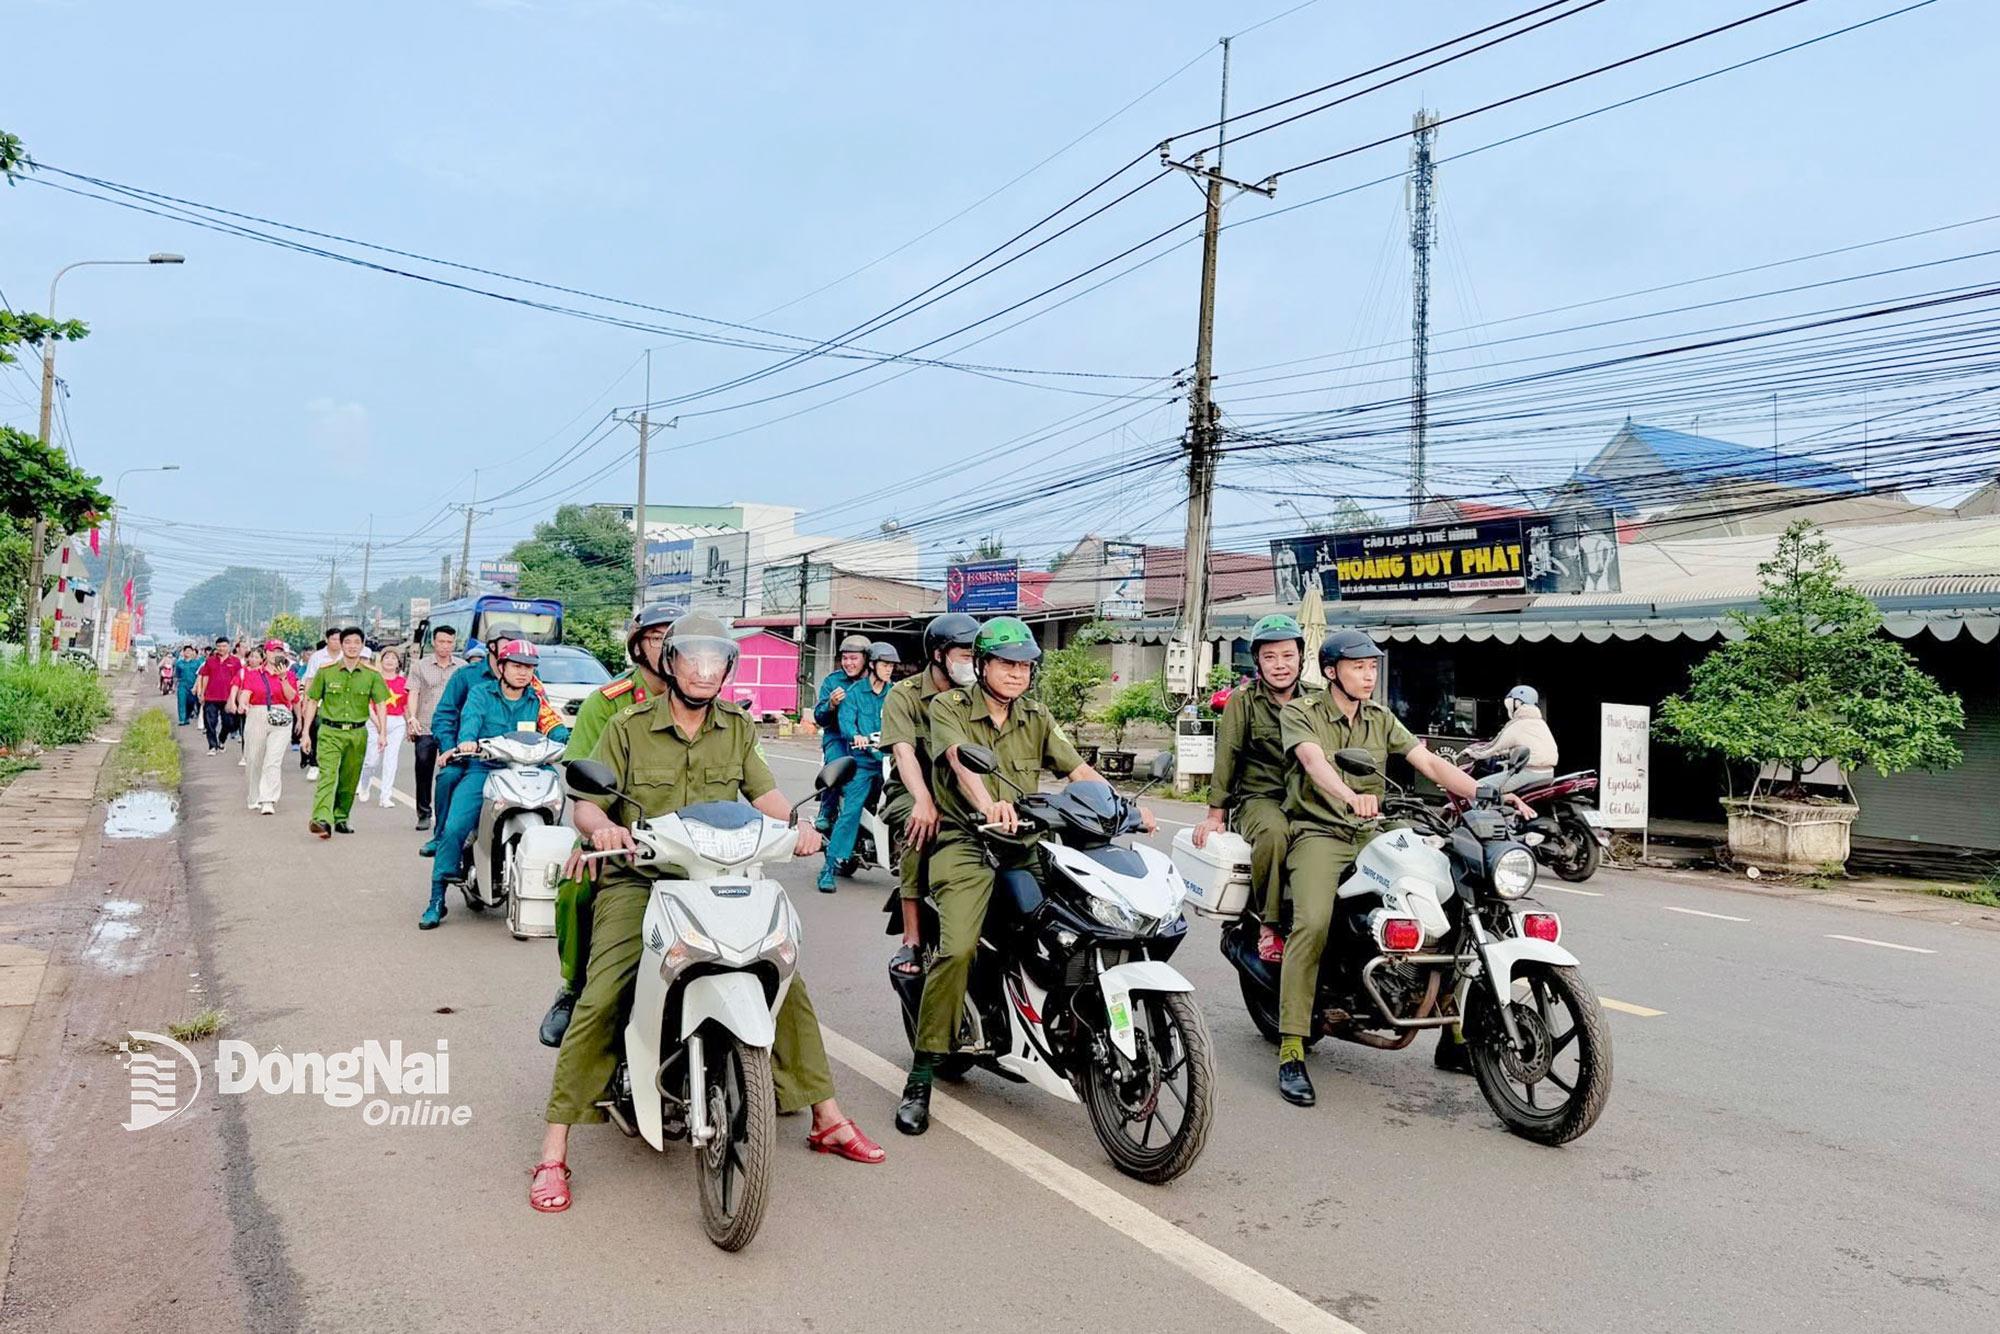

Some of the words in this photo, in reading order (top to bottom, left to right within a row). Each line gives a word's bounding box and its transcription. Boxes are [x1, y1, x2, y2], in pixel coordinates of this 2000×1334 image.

[1386, 535, 1407, 548] LẠC
[1337, 550, 1405, 581] HOÀNG
[1411, 549, 1453, 577] DUY
[512, 601, 531, 610] VIP
[1376, 873, 1390, 889] POLICE
[1190, 882, 1203, 897] POLICE
